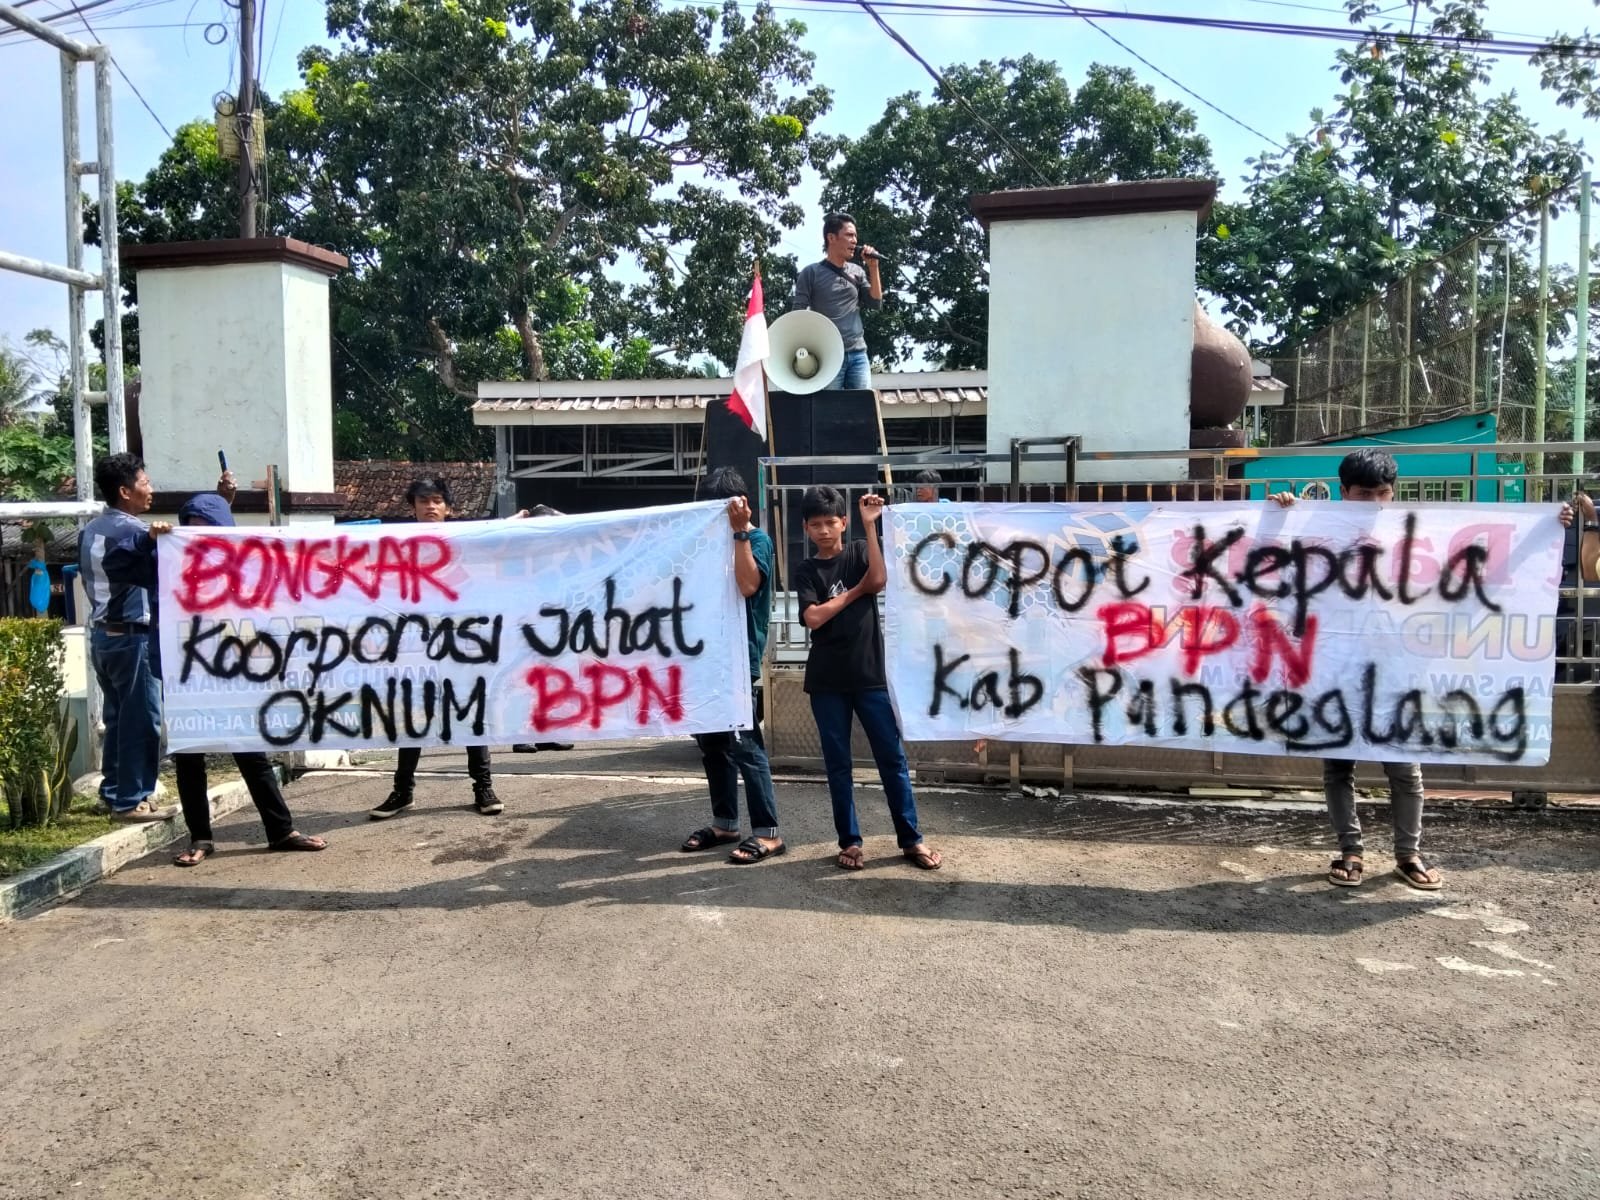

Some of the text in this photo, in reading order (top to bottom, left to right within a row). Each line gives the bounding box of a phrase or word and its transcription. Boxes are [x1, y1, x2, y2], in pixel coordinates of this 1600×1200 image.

[174, 534, 460, 614] BONGKAR
[519, 574, 704, 658] Jahat
[910, 531, 1150, 619] Copot
[1178, 511, 1503, 637] Kepala
[1096, 600, 1320, 688] BPN
[259, 662, 685, 746] OKNUM BPN
[929, 643, 1528, 763] Kab Pandeglang
